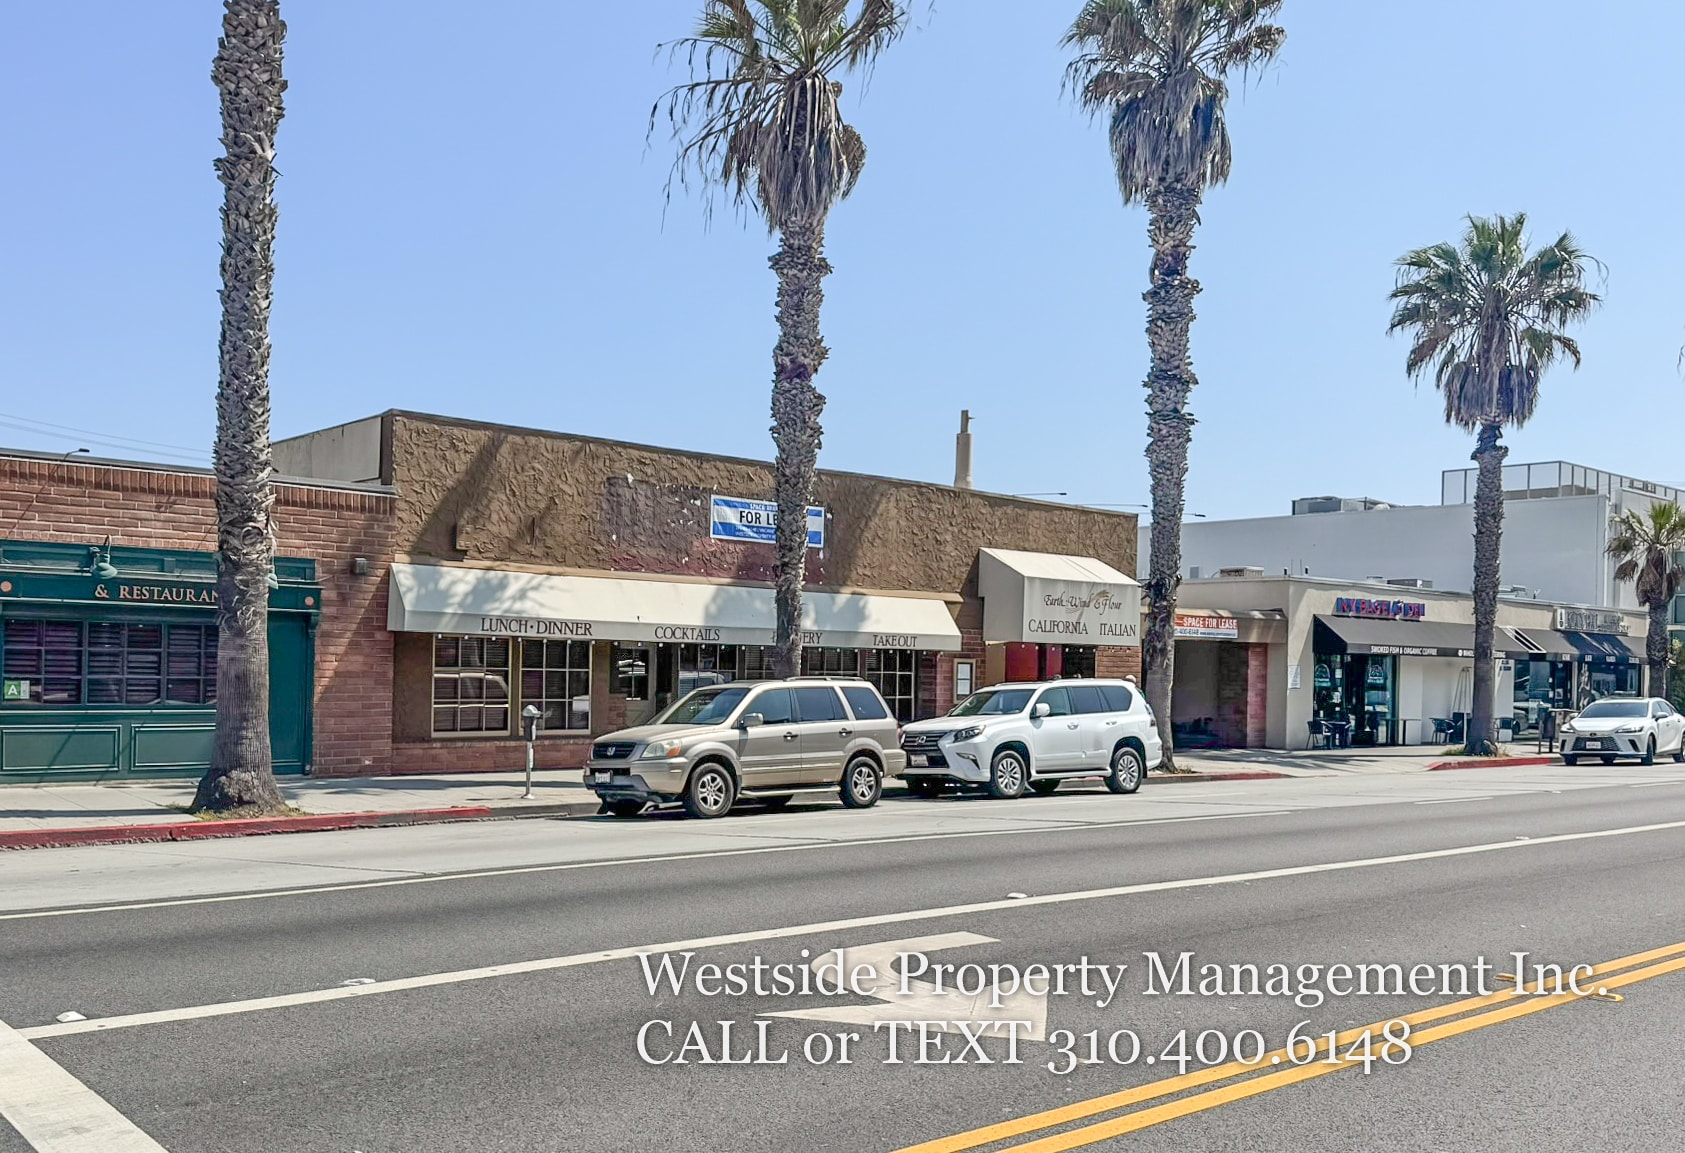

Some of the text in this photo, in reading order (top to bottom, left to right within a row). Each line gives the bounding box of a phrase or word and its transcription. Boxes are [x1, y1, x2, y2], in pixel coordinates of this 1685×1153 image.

[739, 510, 761, 525] FOR
[94, 584, 219, 603] & RESTAURAN
[1028, 619, 1136, 636] CALIFORNIA ITALIAN
[1183, 616, 1238, 629] SPACE FOR LEASE
[654, 626, 720, 641] COCKTAILS
[8, 684, 18, 695] A
